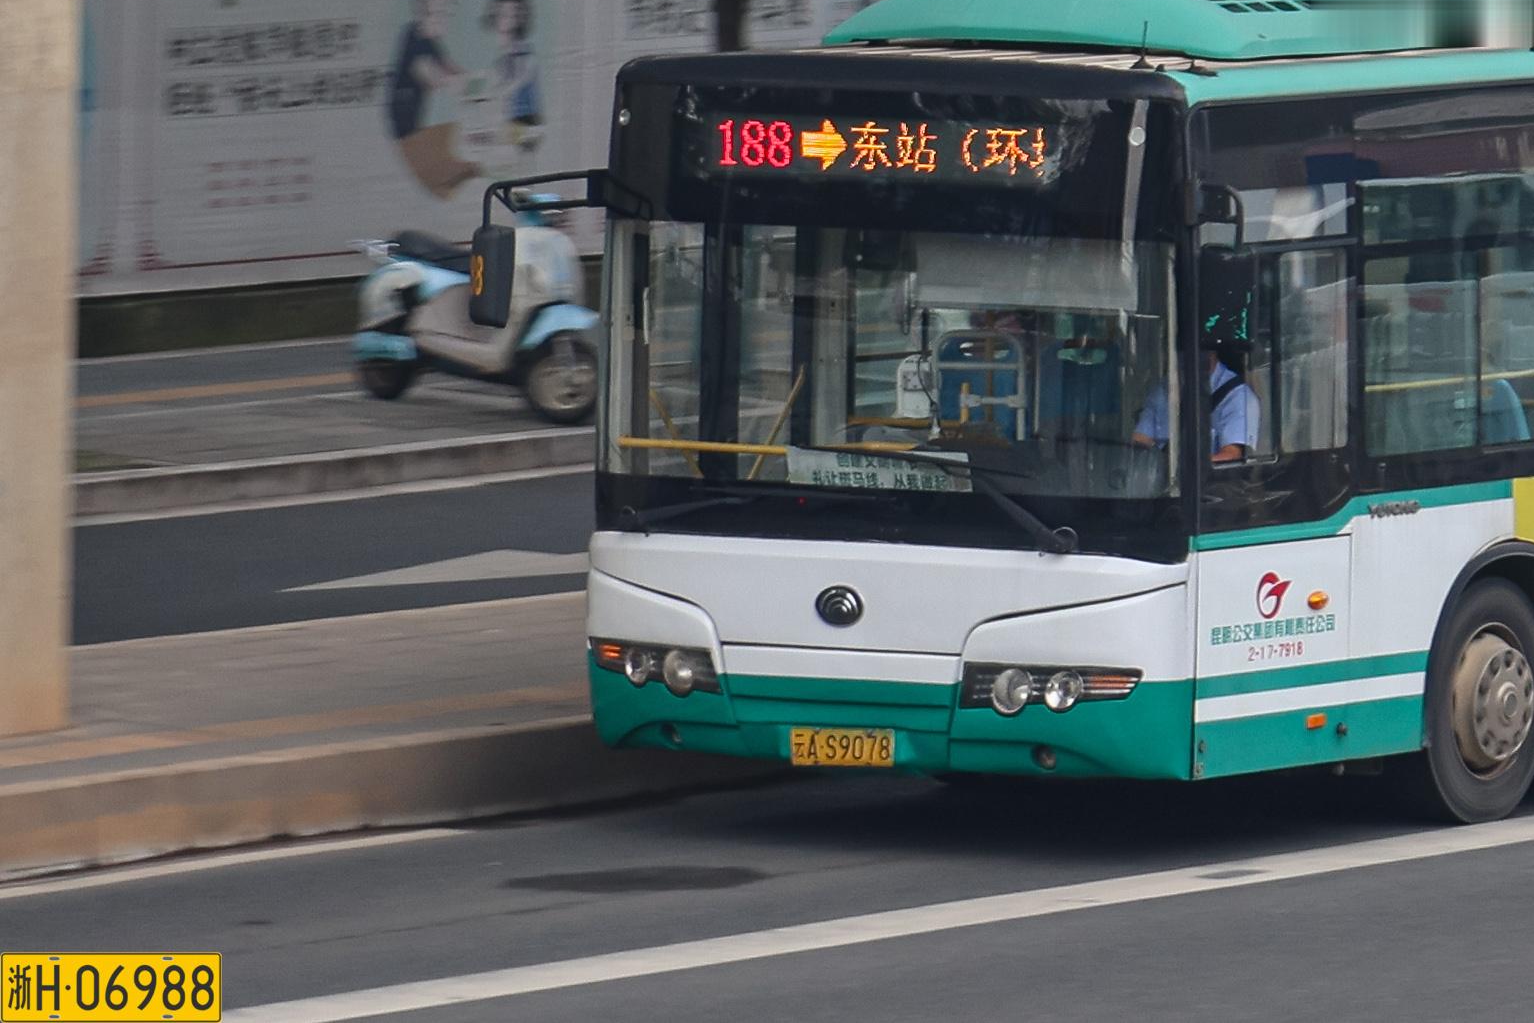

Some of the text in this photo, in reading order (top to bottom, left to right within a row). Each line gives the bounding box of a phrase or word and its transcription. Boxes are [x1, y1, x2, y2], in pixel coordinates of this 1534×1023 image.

[718, 120, 794, 168] 188
[1210, 614, 1336, 646] 昆明公交集团有限责任公司
